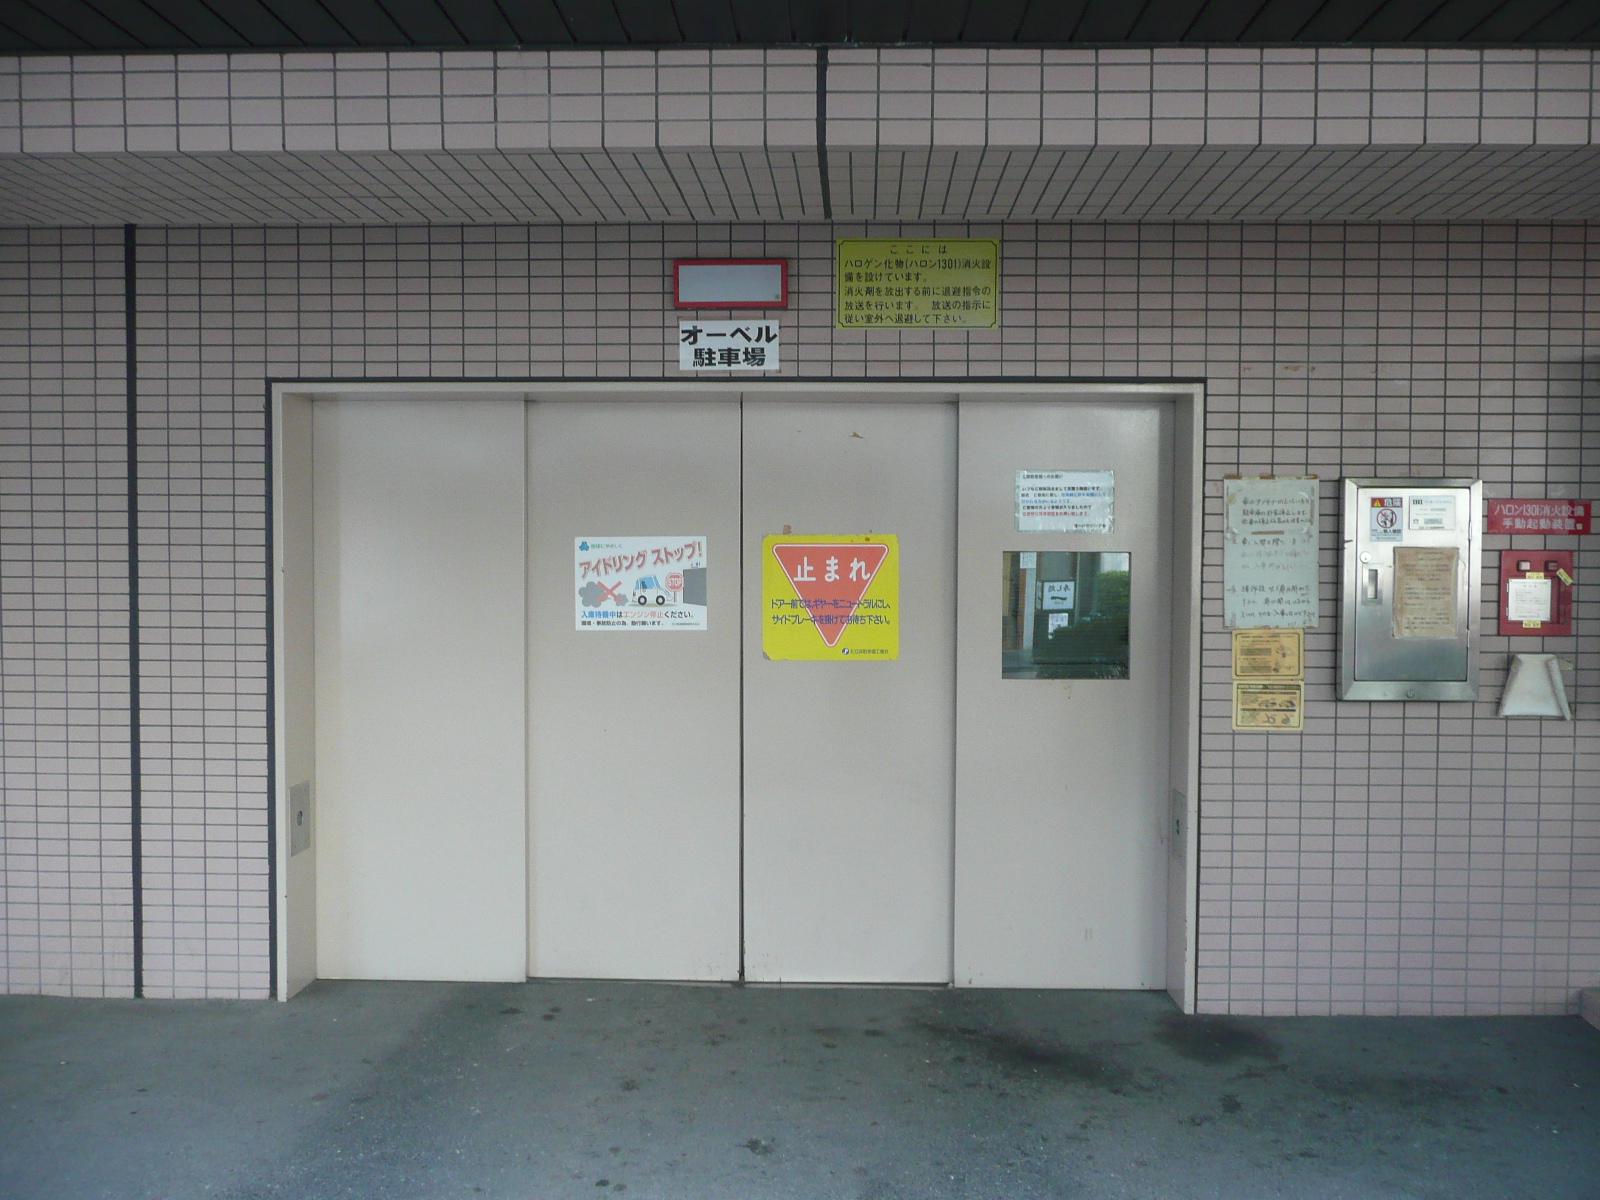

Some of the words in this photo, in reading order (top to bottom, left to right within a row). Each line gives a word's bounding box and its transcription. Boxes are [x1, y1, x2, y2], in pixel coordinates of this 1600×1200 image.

[889, 245, 947, 255] ここには
[681, 325, 778, 344] オーベル
[692, 347, 766, 367] 駐車場
[579, 550, 648, 579] アイドリング
[793, 555, 872, 582] 止まれ
